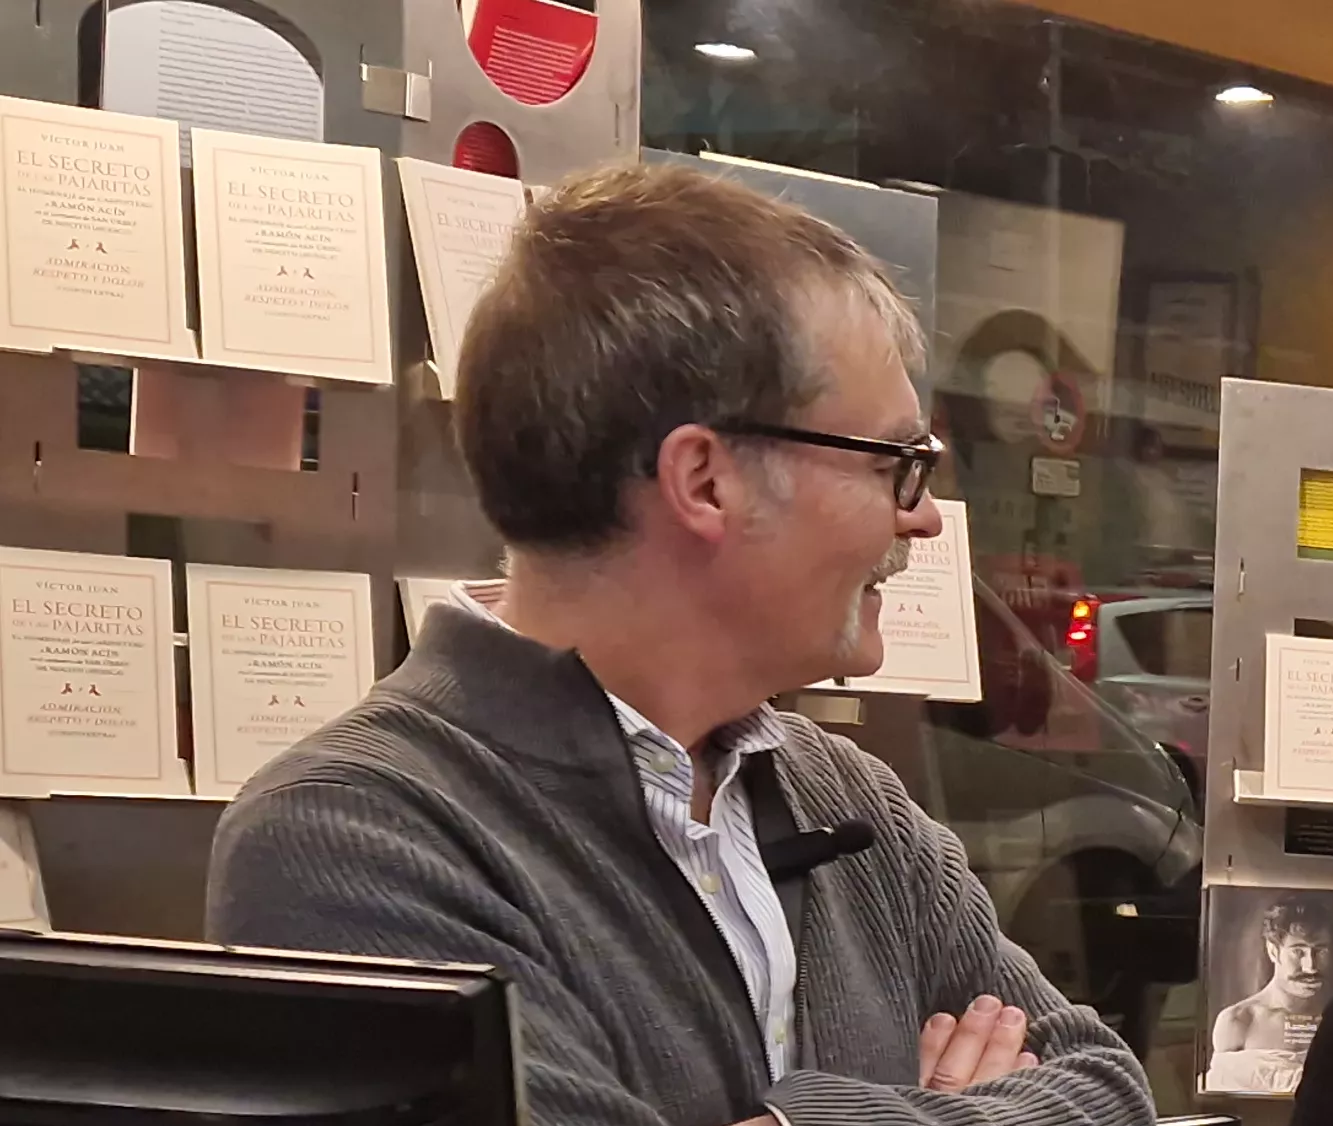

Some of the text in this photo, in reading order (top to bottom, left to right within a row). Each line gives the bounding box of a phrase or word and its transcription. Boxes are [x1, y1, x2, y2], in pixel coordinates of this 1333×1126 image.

[94, 142, 125, 152] JUAN
[17, 150, 150, 180] EL SECRETO
[58, 174, 151, 197] PAJARITAS
[228, 181, 354, 208] EL SECRETO
[267, 204, 355, 222] PAJARITAS
[437, 212, 450, 225] EL
[36, 581, 83, 591] VÍCTOR
[12, 599, 142, 620] EL SECRETO
[53, 620, 143, 636] PAJARITAS
[222, 614, 344, 633] EL SECRETO
[260, 634, 345, 648] PAJARITAS
[1287, 671, 1302, 681] EL
